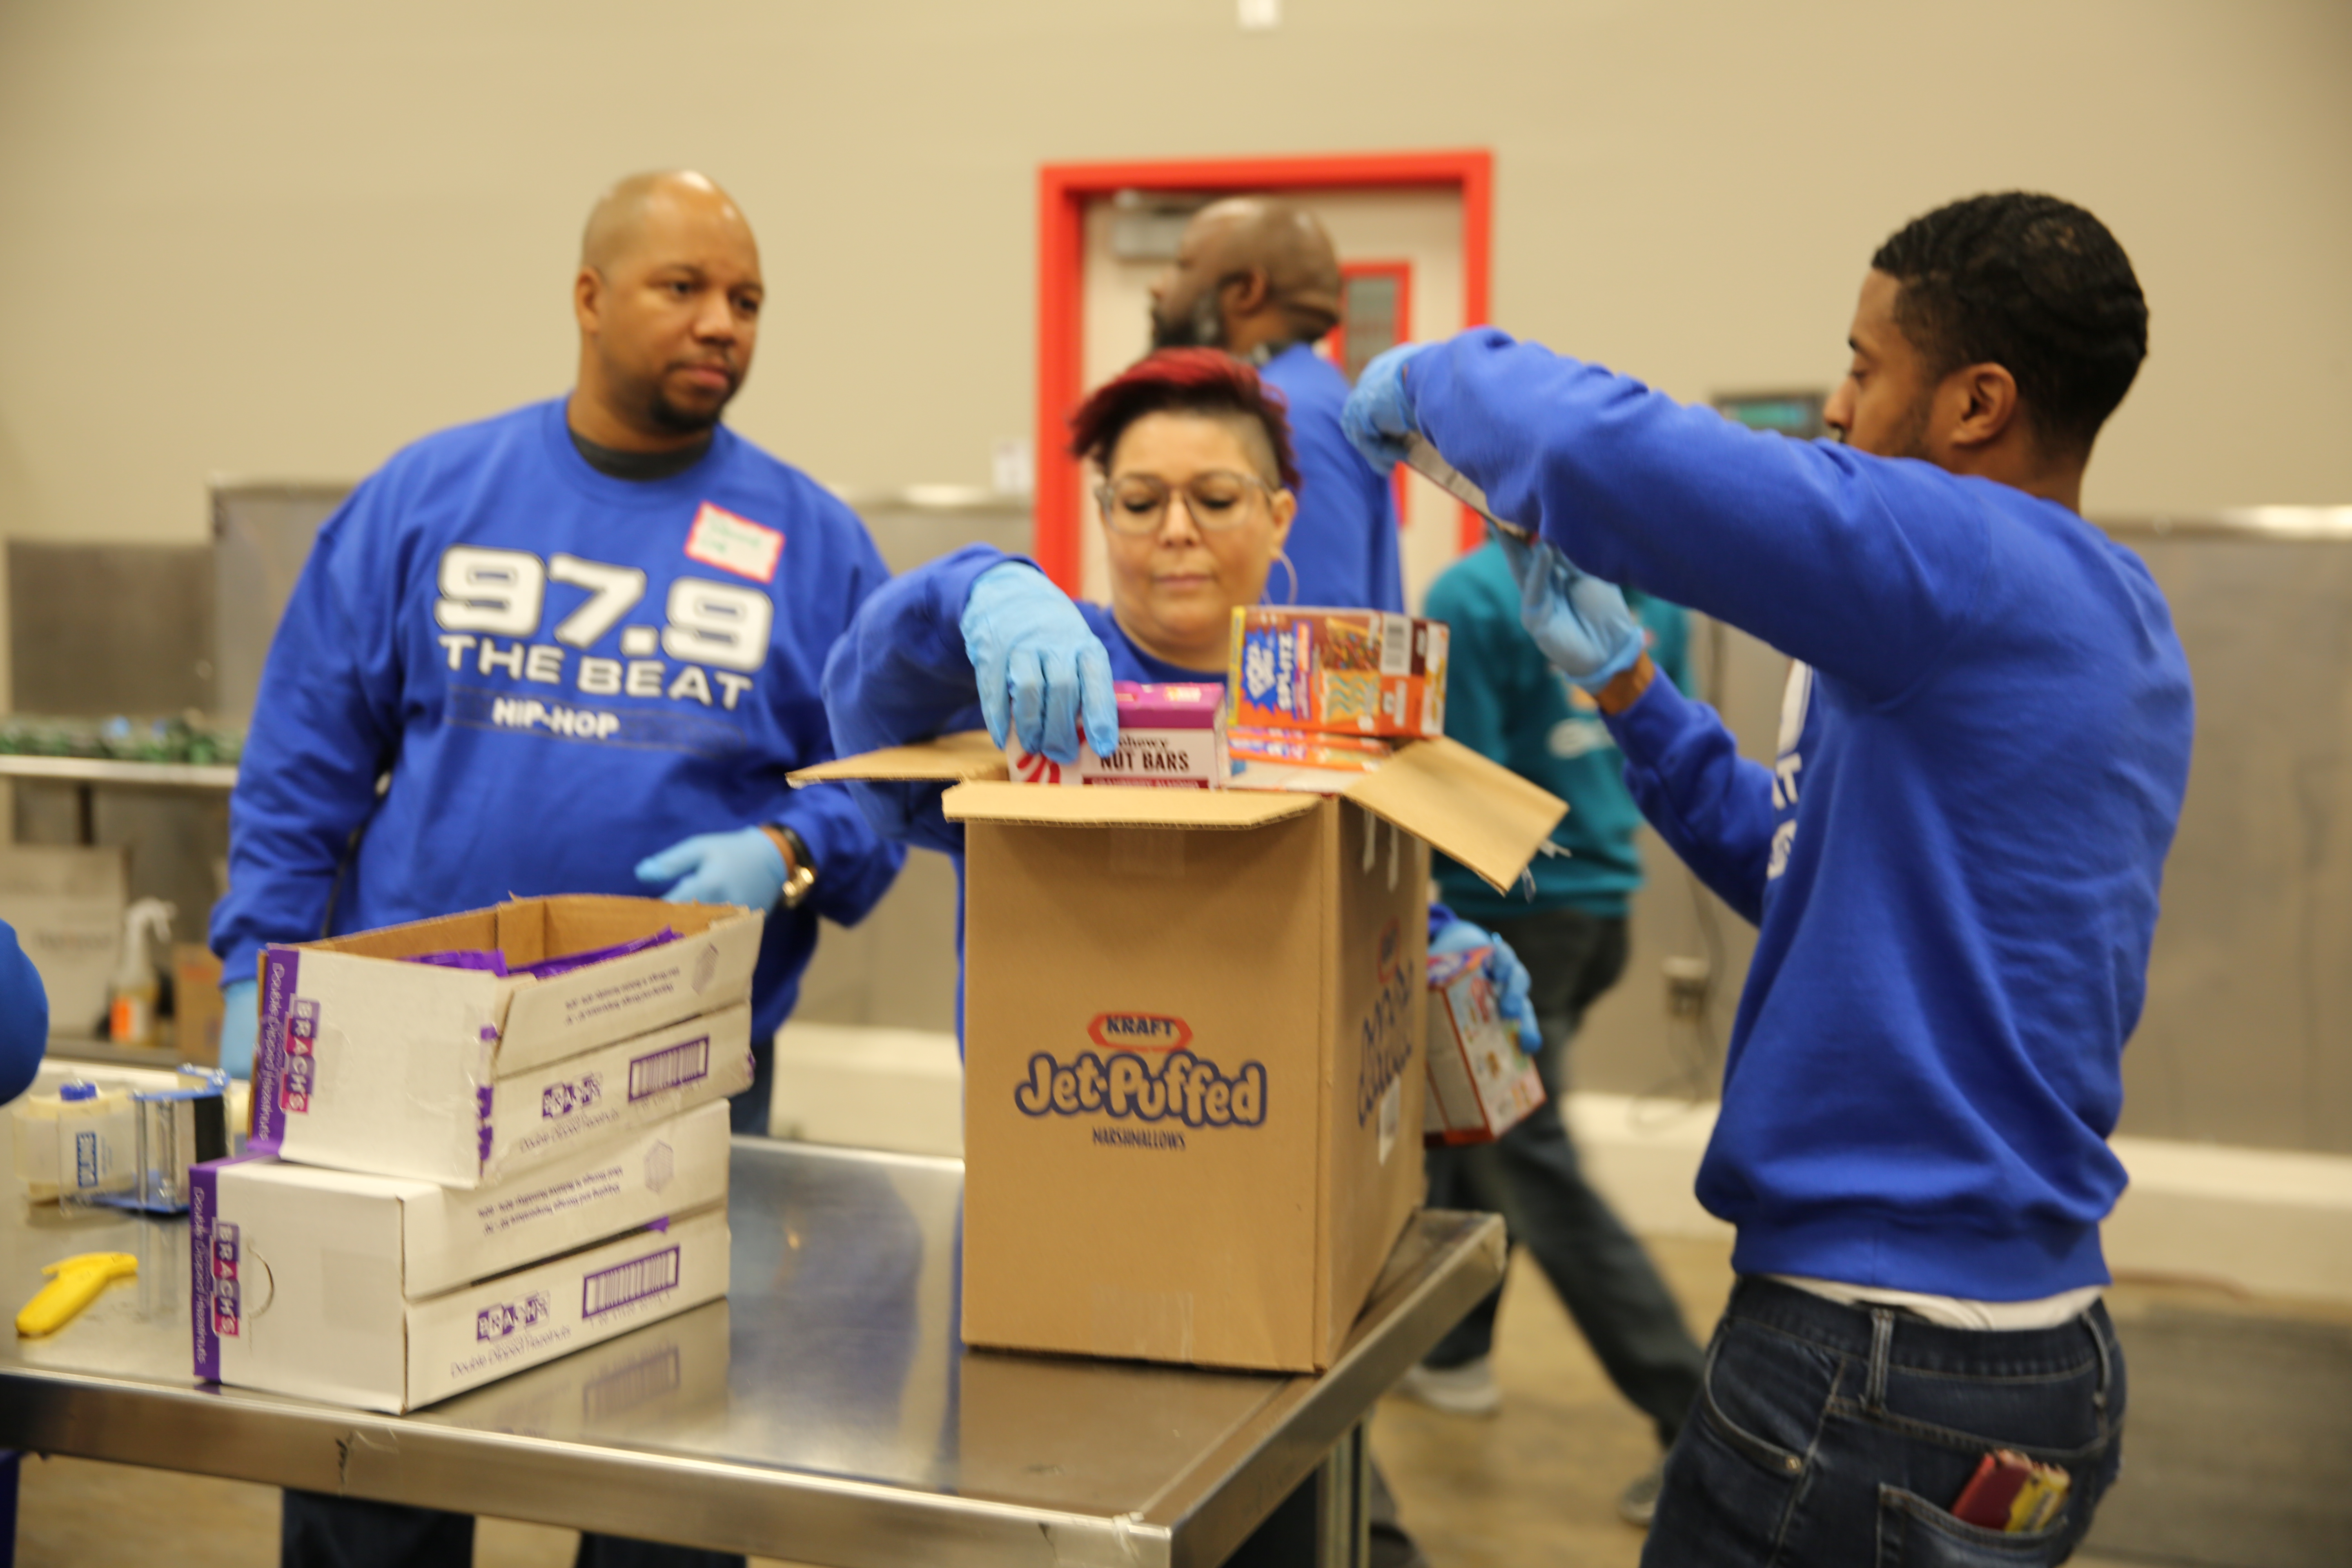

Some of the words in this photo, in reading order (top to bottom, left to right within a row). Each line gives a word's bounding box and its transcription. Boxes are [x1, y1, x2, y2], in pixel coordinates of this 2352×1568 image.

[434, 543, 773, 672] 97.9
[439, 634, 565, 684] THE
[577, 655, 753, 711] BEAT
[492, 696, 620, 739] HIP-HOP
[1100, 751, 1134, 771] NUT
[1143, 751, 1189, 771] BARS
[1107, 1015, 1172, 1037] KRAFT
[1092, 1126, 1186, 1151] MARSHMALLOWS
